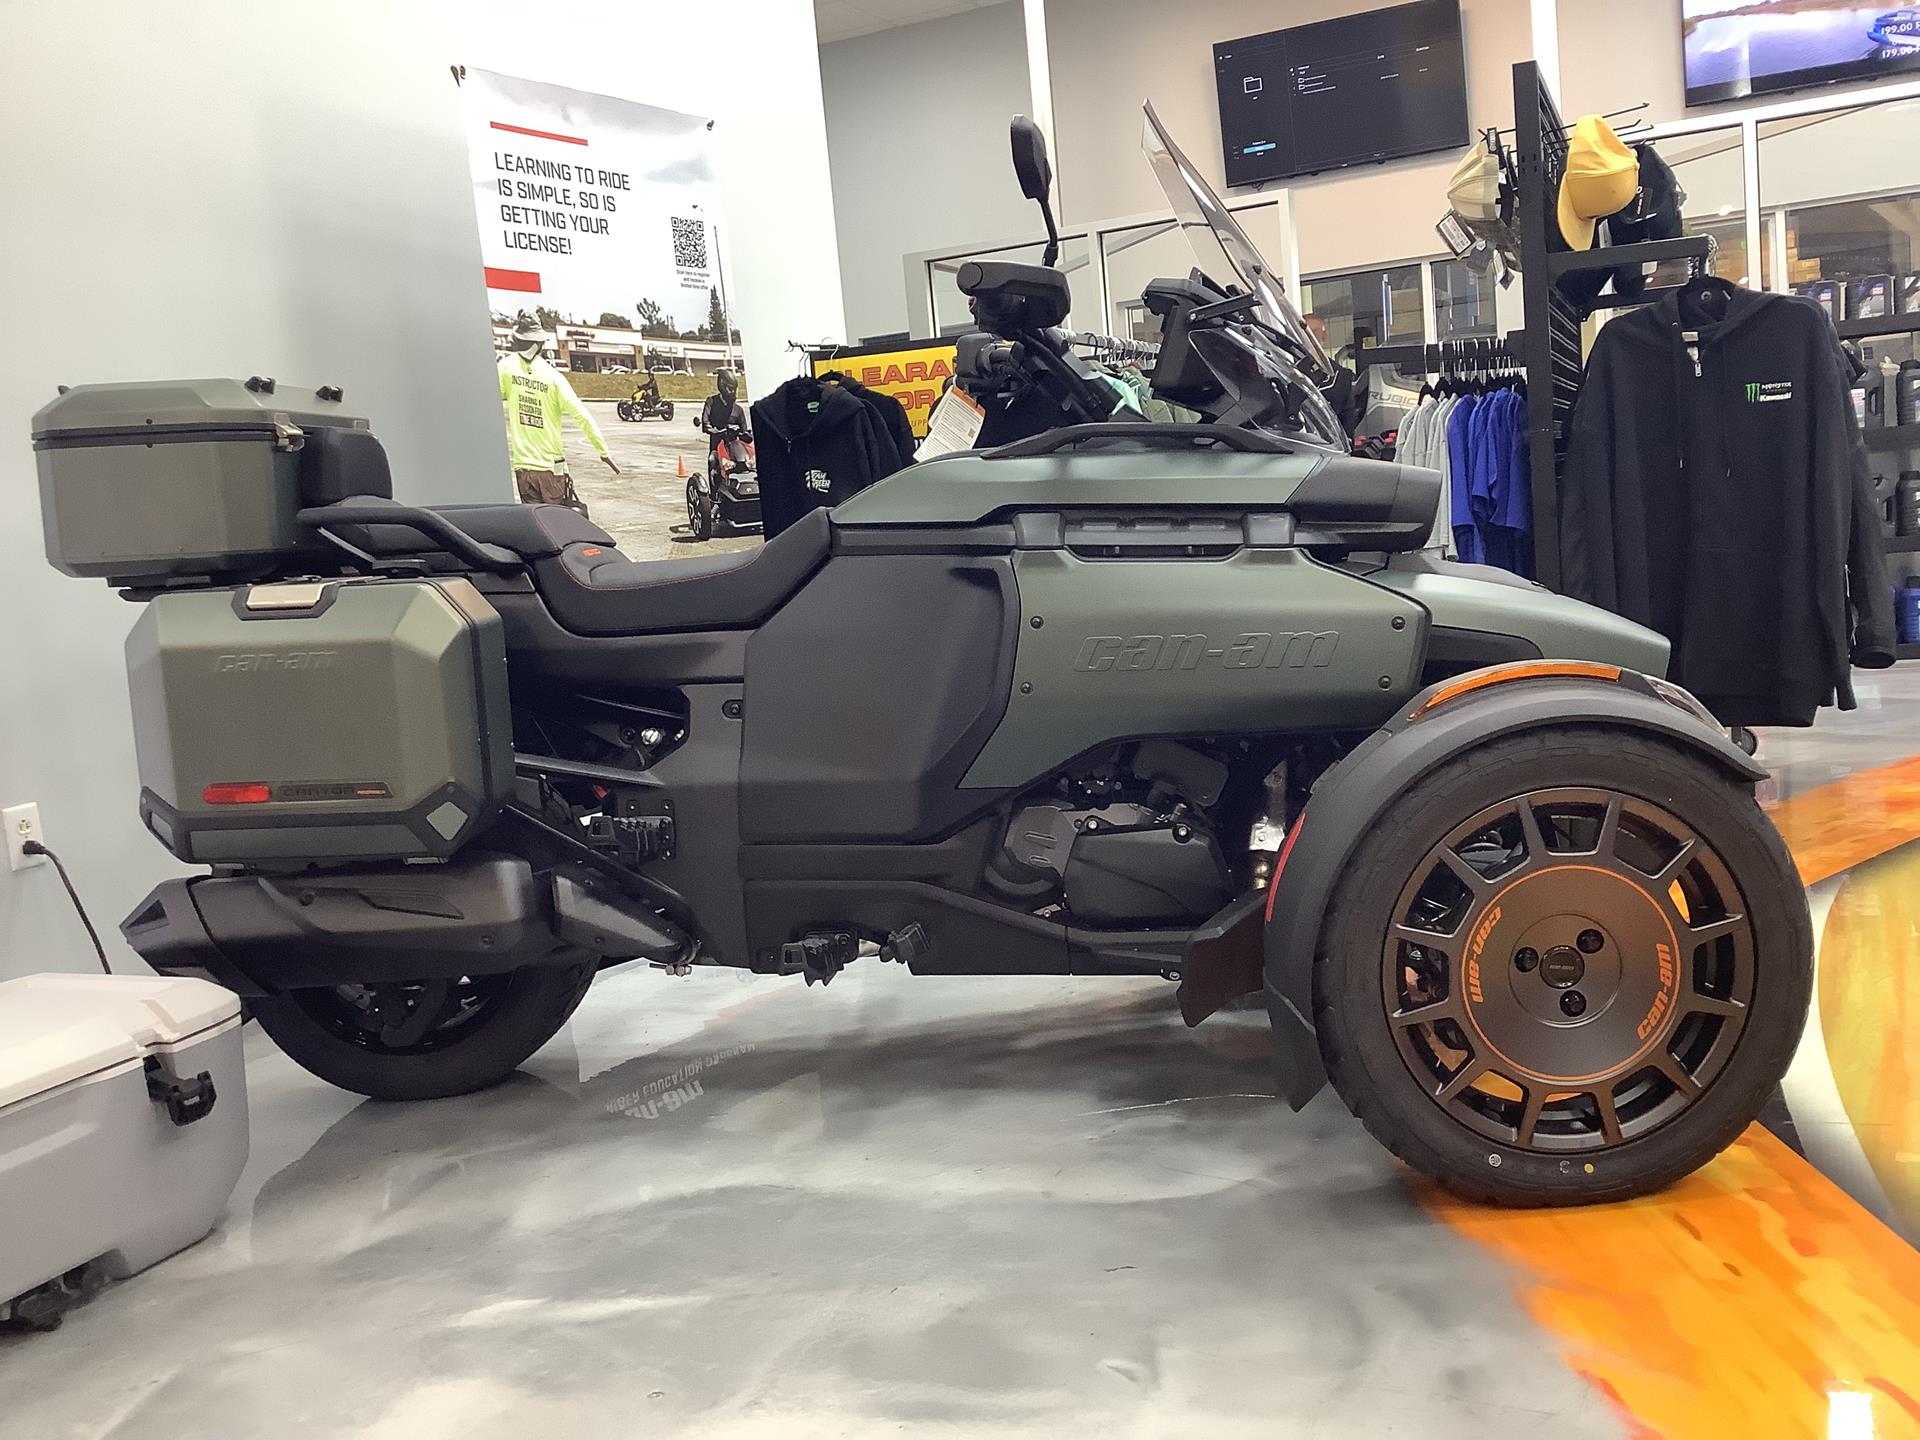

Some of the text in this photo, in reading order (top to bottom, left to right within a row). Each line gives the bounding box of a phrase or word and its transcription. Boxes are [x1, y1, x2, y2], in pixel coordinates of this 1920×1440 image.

[494, 151, 631, 191] LEARNING TO RIDE
[497, 178, 616, 212] IS SIMPLE, SO IS
[500, 204, 610, 236] GETTING YOUR
[503, 230, 572, 256] LICENSE!
[511, 374, 549, 394] INSTRUCTOR
[215, 650, 338, 673] can-am
[1073, 630, 1340, 672] can-am
[1470, 906, 1502, 1004] can-am
[1637, 942, 1673, 1040] can-am
